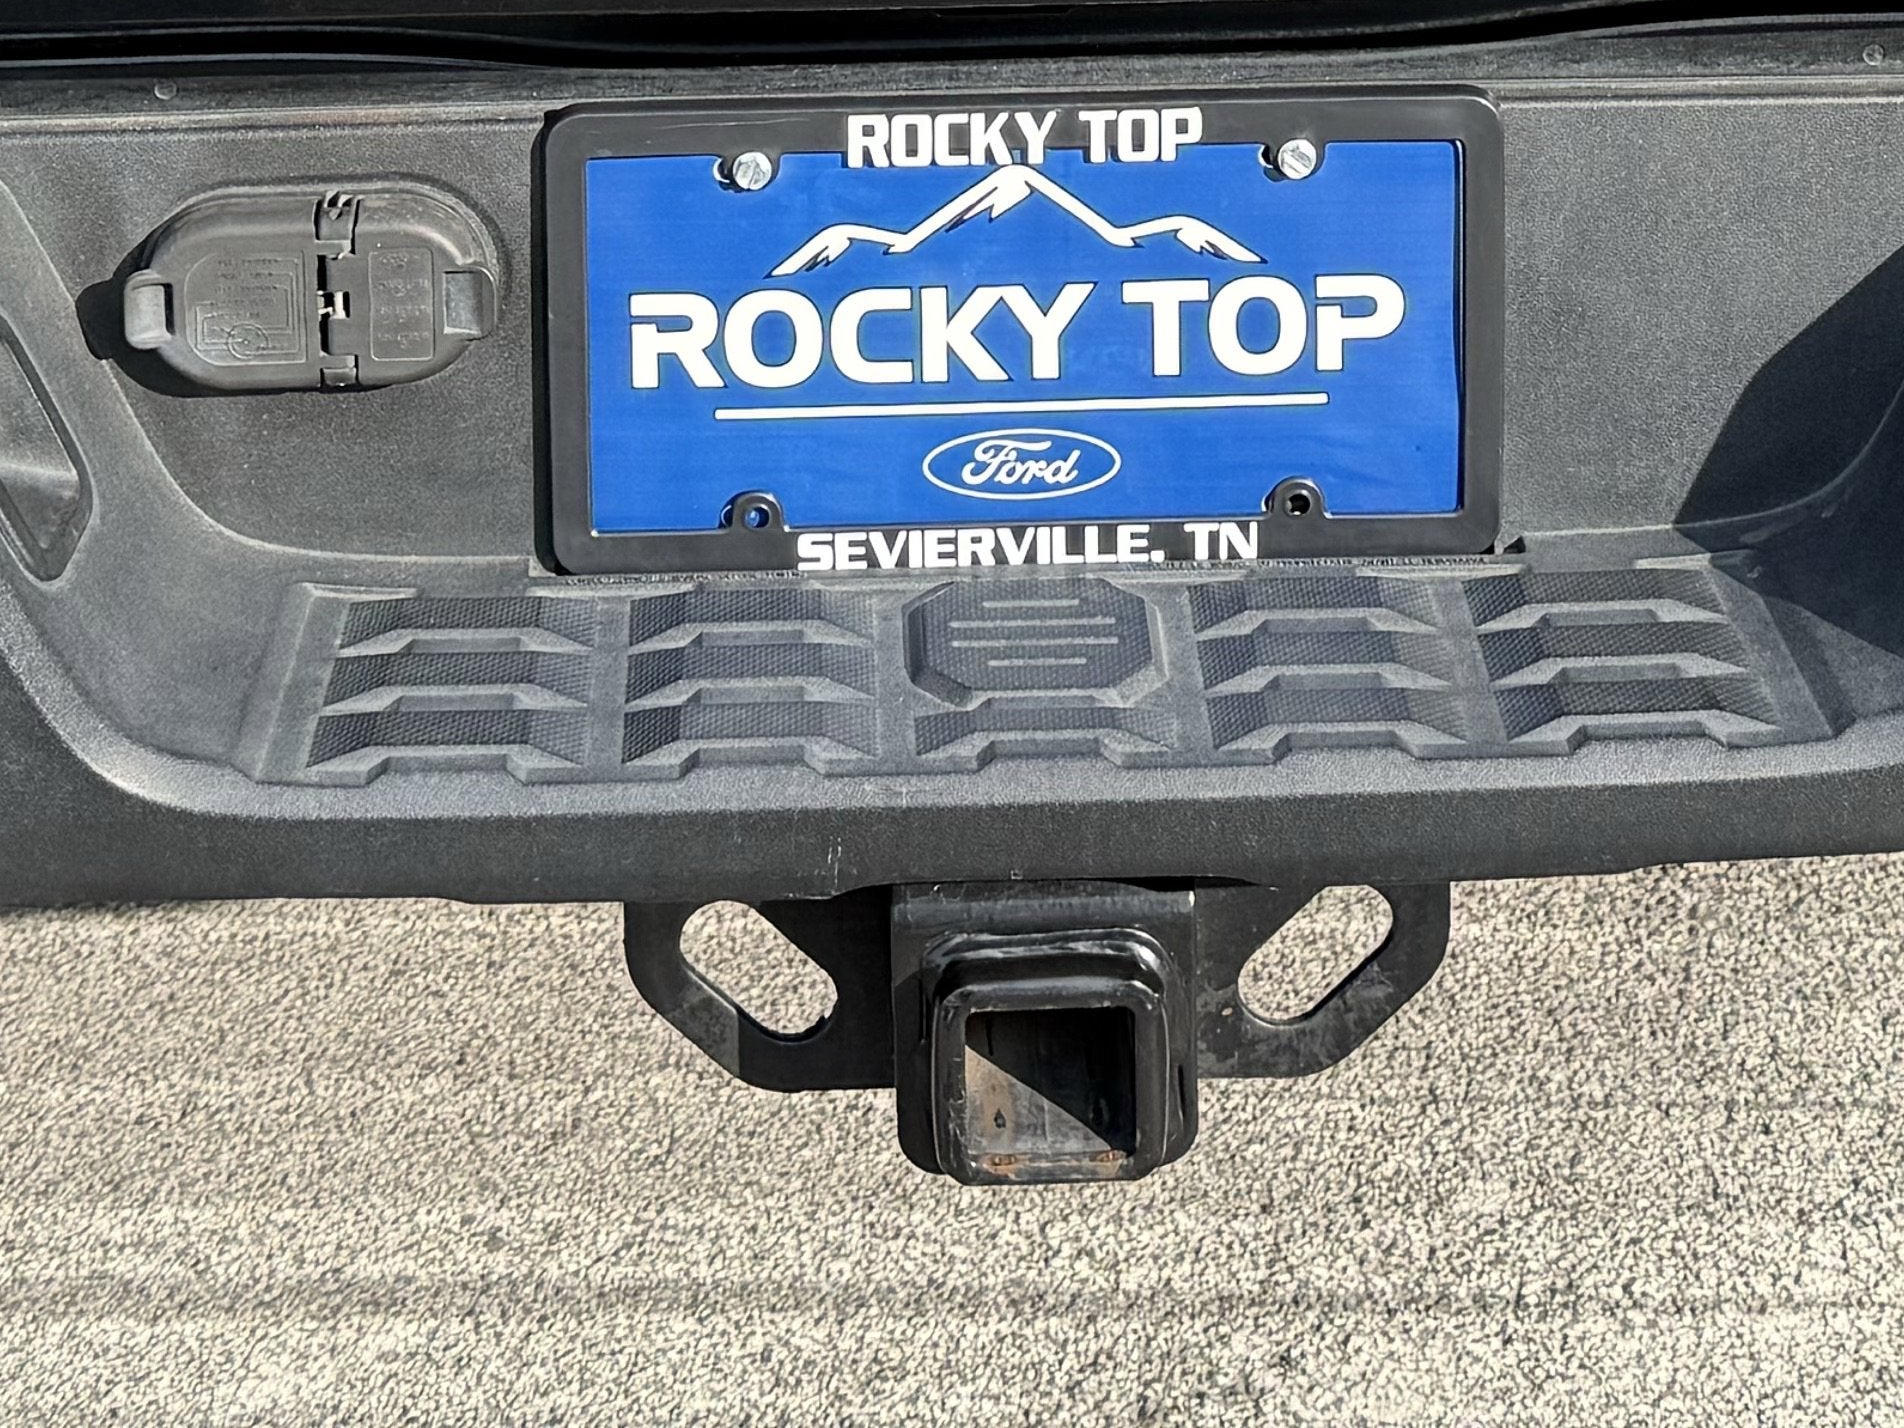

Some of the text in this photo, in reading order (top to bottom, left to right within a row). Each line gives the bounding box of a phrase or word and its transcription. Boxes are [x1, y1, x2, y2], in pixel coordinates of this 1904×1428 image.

[846, 106, 1204, 168] ROCKY TOP
[629, 273, 1407, 391] ROCKY TOP
[959, 439, 1079, 488] Ford
[1183, 520, 1260, 562] TN
